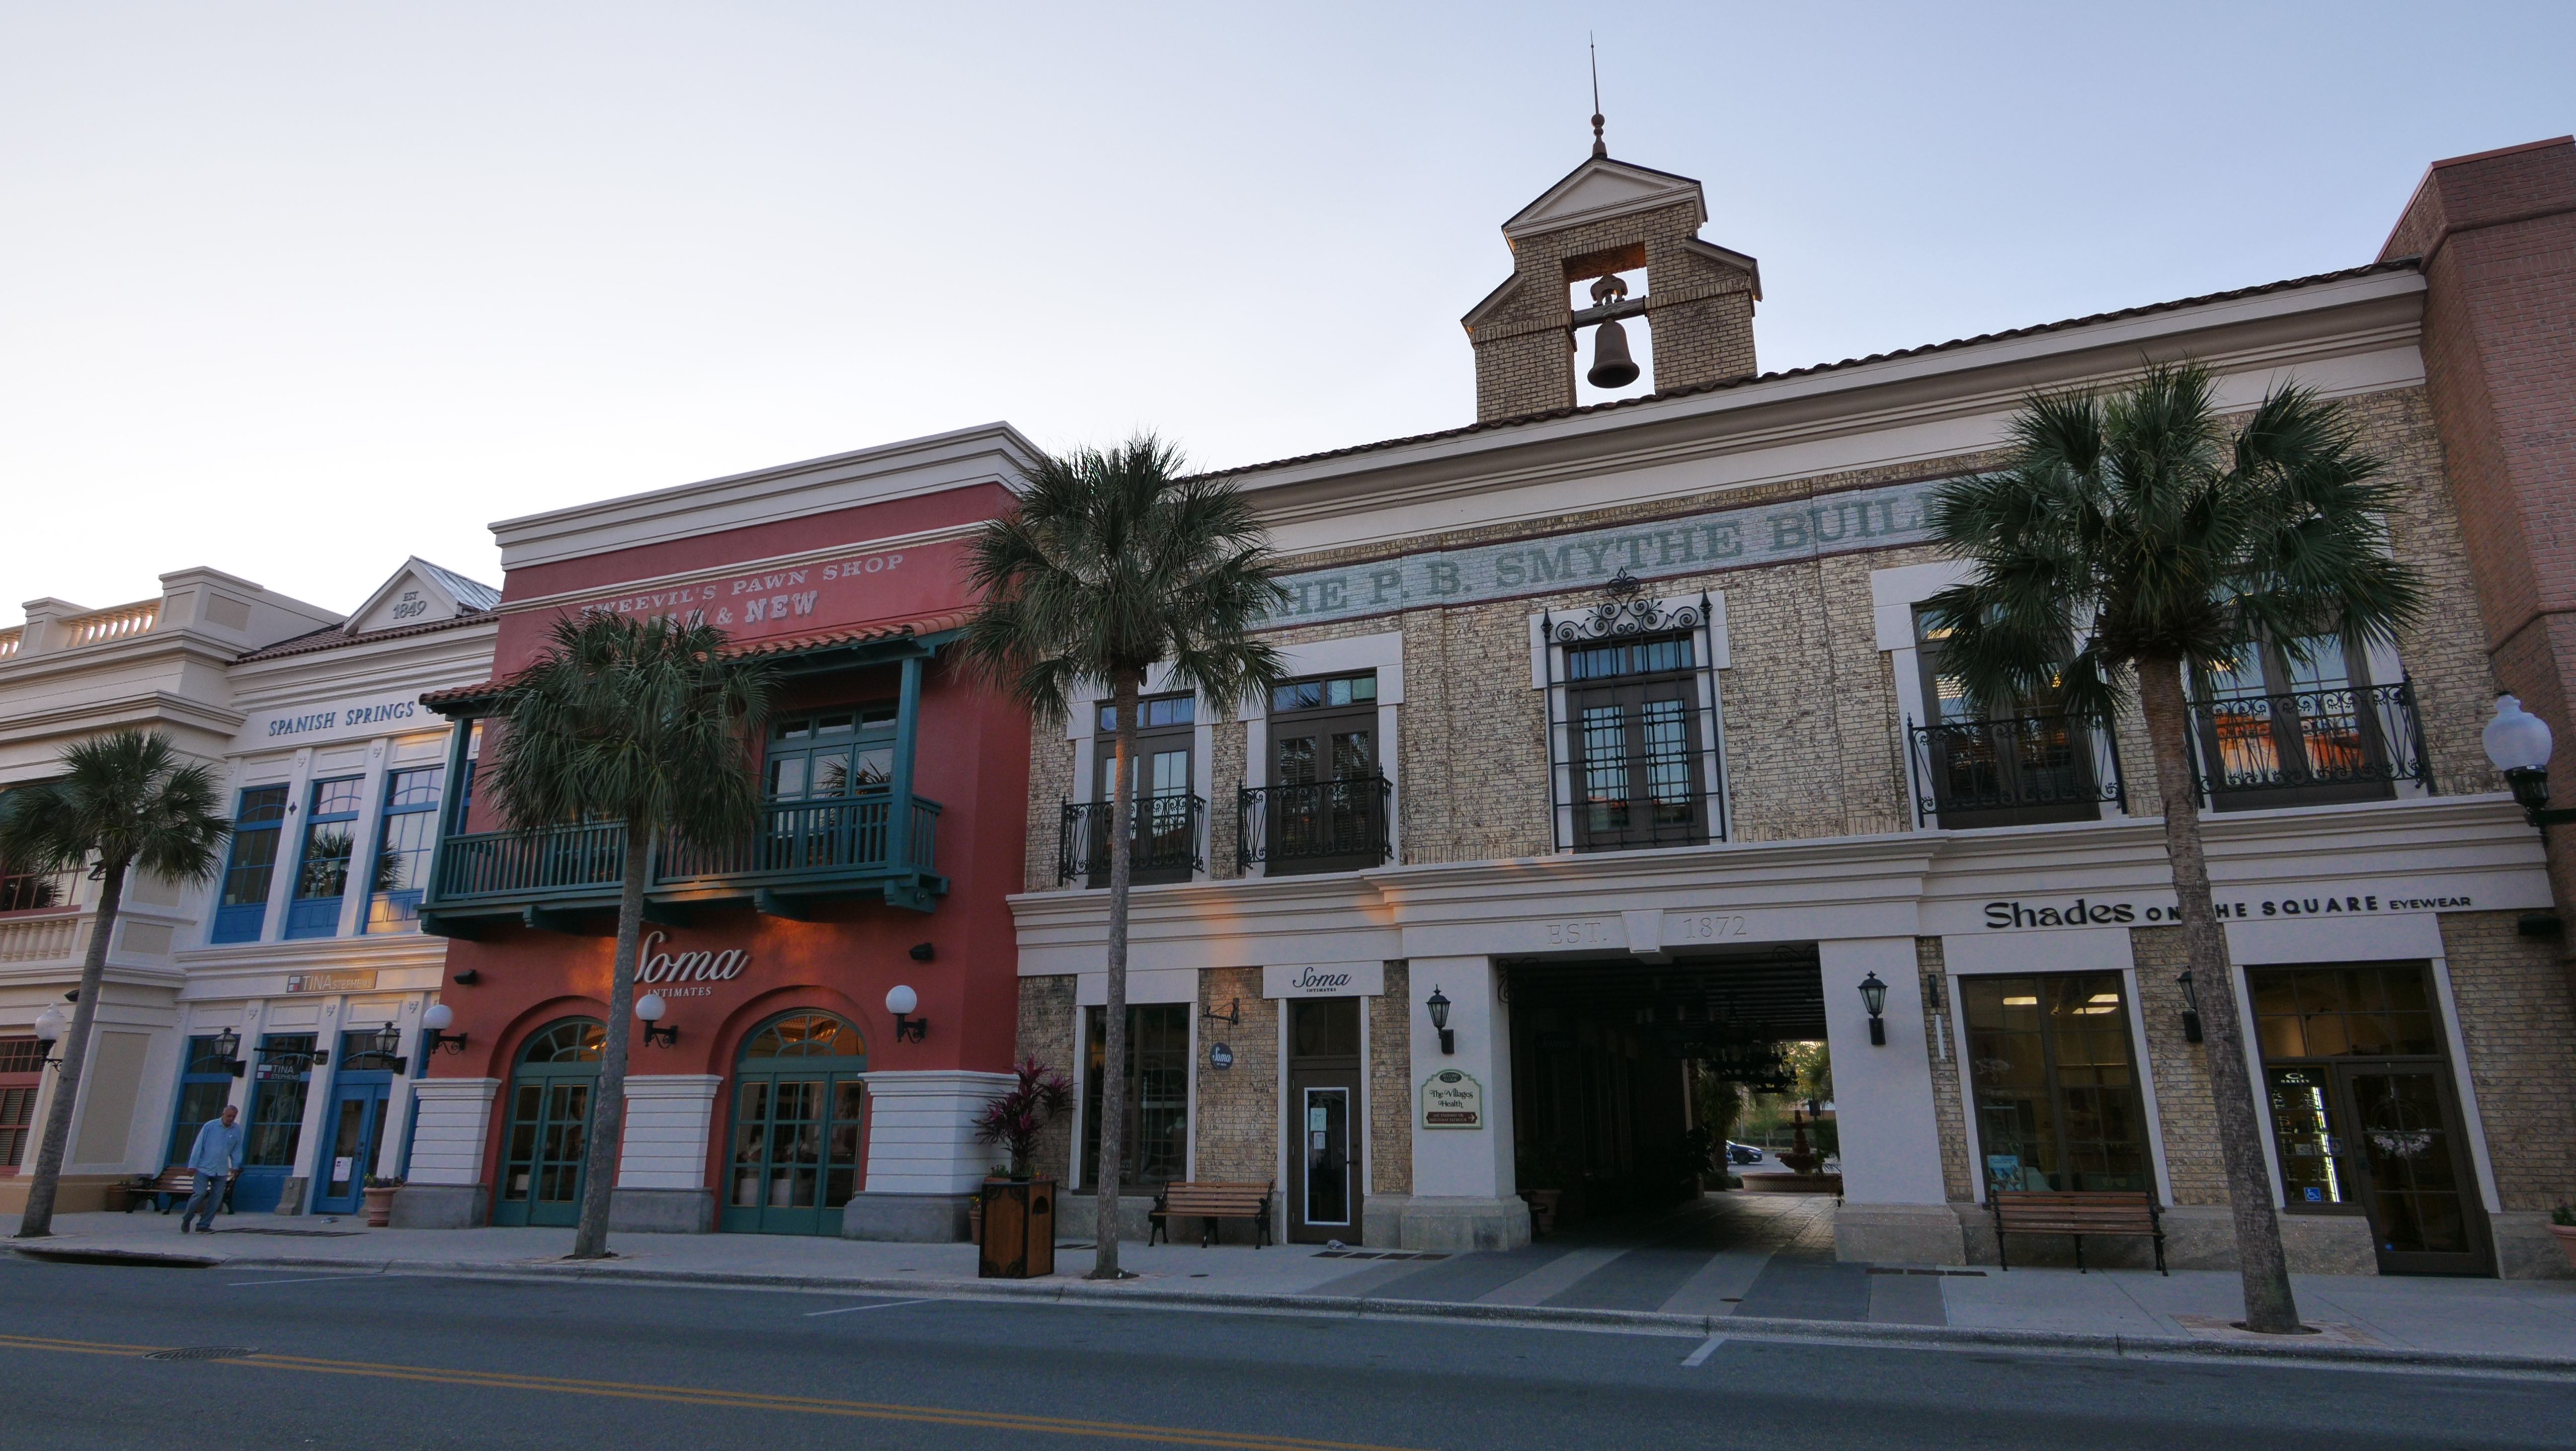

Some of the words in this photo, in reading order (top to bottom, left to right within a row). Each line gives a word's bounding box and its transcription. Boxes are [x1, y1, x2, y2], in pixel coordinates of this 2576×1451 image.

[731, 570, 809, 595] PAWN
[822, 554, 903, 580] SHOP
[1249, 575, 1347, 619] HE
[1368, 569, 1410, 605] P.
[1425, 561, 1472, 597] B.
[1495, 520, 1743, 587] SMYTHE
[402, 590, 419, 601] EST
[393, 600, 427, 619] 1849
[717, 607, 733, 625] &
[744, 590, 819, 624] NEW
[268, 712, 336, 736] SPANISH
[345, 701, 415, 726] SPRINGS
[1984, 898, 2135, 929] Shades
[2215, 902, 2247, 918] HE
[2261, 895, 2378, 916] SQUARE
[2389, 896, 2472, 910] EYEWEAR
[1546, 922, 1608, 945] EST.
[1683, 916, 1747, 939] 1872
[634, 930, 749, 983] Soma
[302, 975, 332, 991] TINA
[332, 978, 372, 990] STEPHENS
[1292, 967, 1352, 988] Soma
[647, 986, 712, 998] INTIMATES
[1212, 1047, 1232, 1063] Soma
[273, 1065, 294, 1074] TINA
[1430, 1090, 1444, 1099] The
[1444, 1088, 1473, 1099] Villages
[1438, 1100, 1464, 1109] Health
